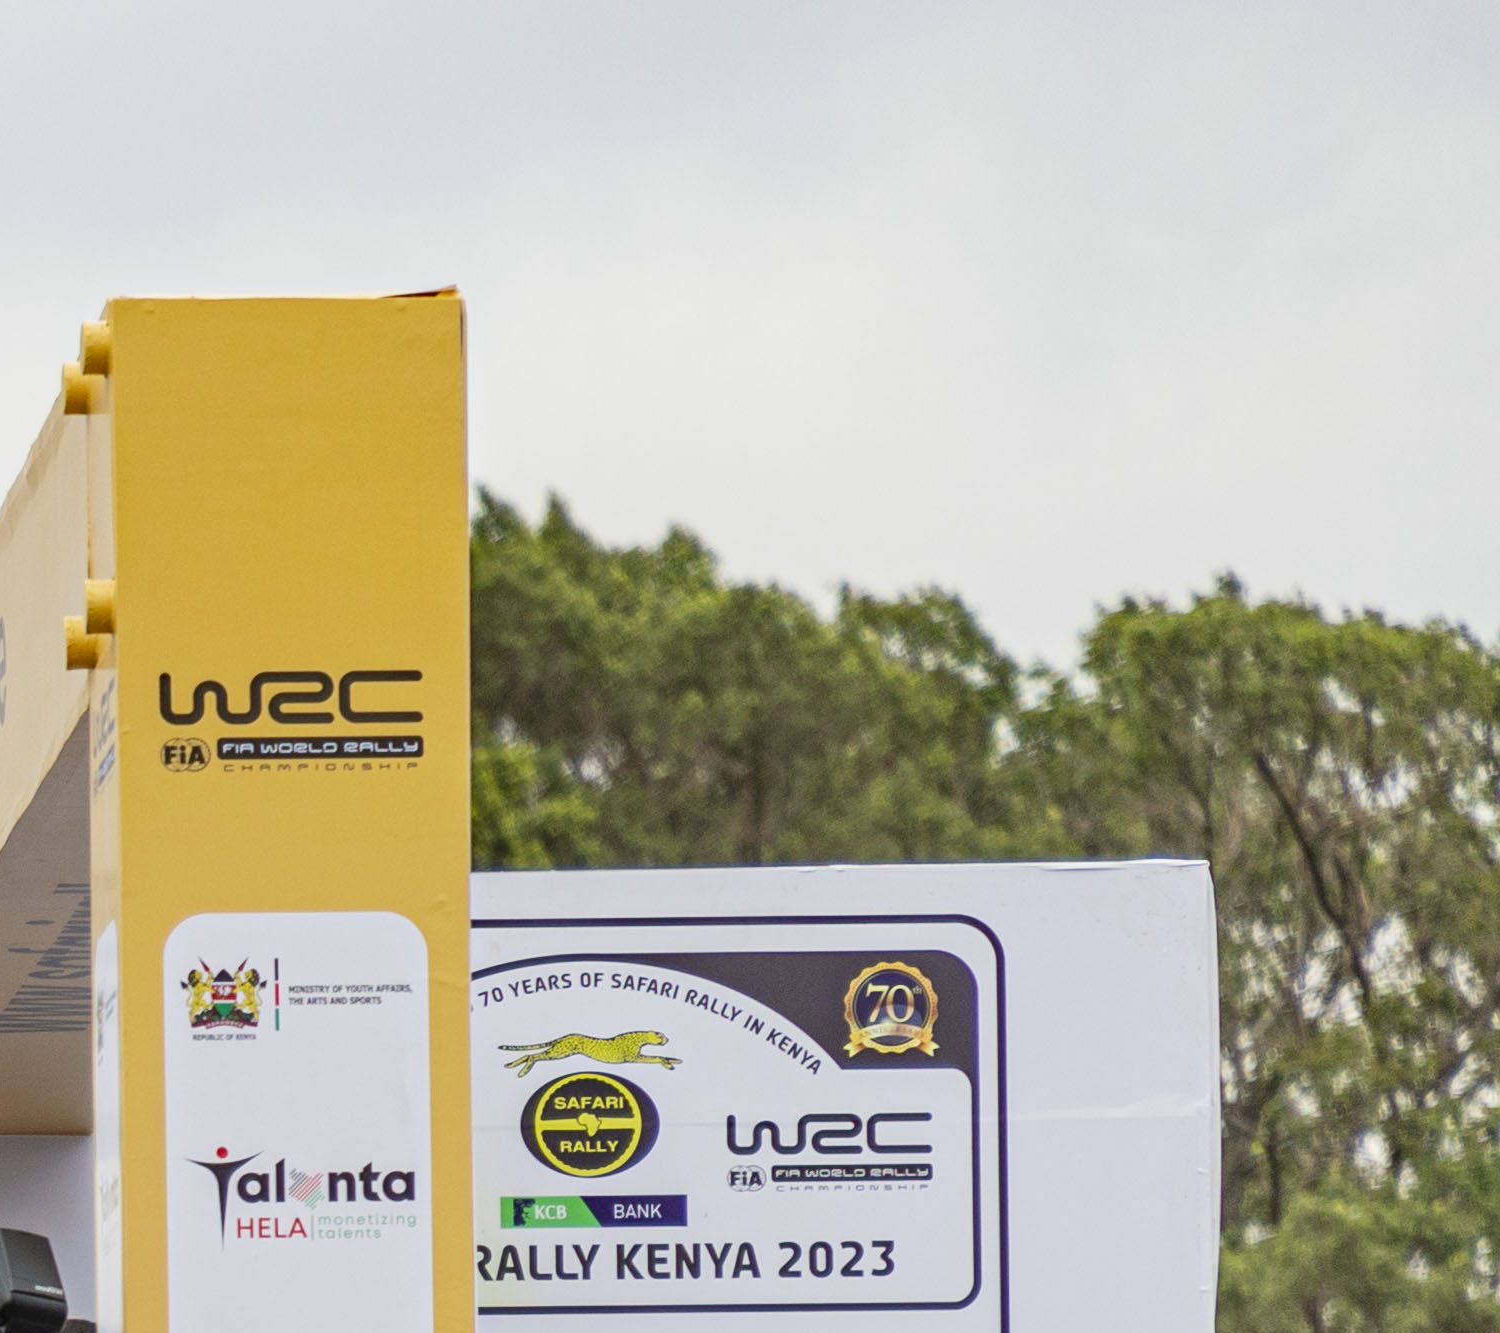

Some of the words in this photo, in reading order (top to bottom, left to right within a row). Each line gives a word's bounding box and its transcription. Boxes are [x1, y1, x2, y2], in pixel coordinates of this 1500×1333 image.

[159, 670, 423, 725] WRC
[223, 741, 254, 755] FIA
[260, 741, 338, 755] WORLD
[344, 741, 419, 755] RALLY
[479, 990, 504, 1008] 70
[508, 974, 572, 997] YEARS
[580, 973, 603, 987] OF
[611, 974, 679, 999] SAFARI
[685, 984, 742, 1025] RALLY
[744, 1015, 764, 1034] IN
[766, 1028, 822, 1076] KENYA
[554, 1097, 623, 1109] SAFARI
[727, 1113, 932, 1155] WRC
[559, 1139, 619, 1153] RALLY
[535, 1205, 567, 1219] KCB
[614, 1204, 662, 1219] BANK
[237, 1218, 307, 1238] HELA
[318, 1214, 416, 1228] monetizing
[318, 1226, 382, 1240] talents
[617, 1242, 760, 1279] KENYA
[779, 1241, 894, 1277] 2023
